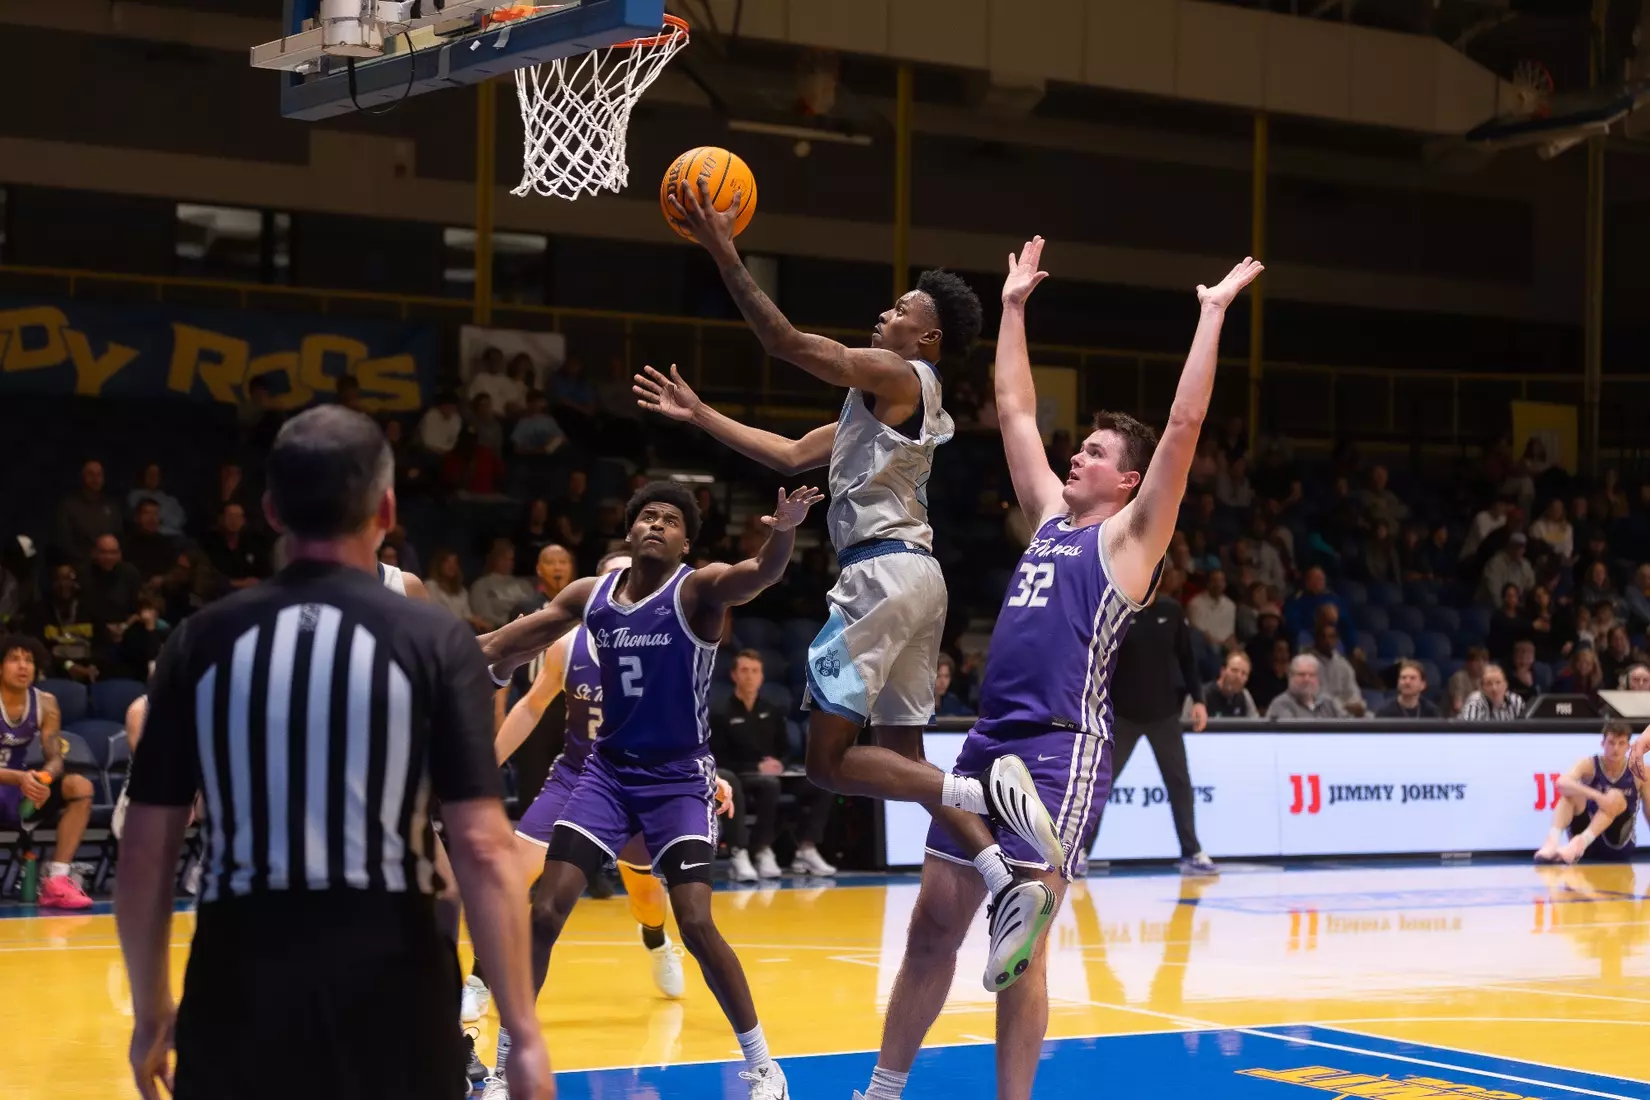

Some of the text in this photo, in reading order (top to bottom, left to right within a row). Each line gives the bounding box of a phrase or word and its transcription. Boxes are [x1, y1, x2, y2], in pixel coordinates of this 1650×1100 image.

[165, 320, 421, 412] ROOS
[1007, 561, 1056, 608] 32
[595, 627, 673, 649] St. Thomas
[618, 655, 644, 698] 2
[1142, 785, 1215, 808] JO'S
[1328, 784, 1395, 805] JIMMY
[1401, 784, 1467, 804] JOHN'S
